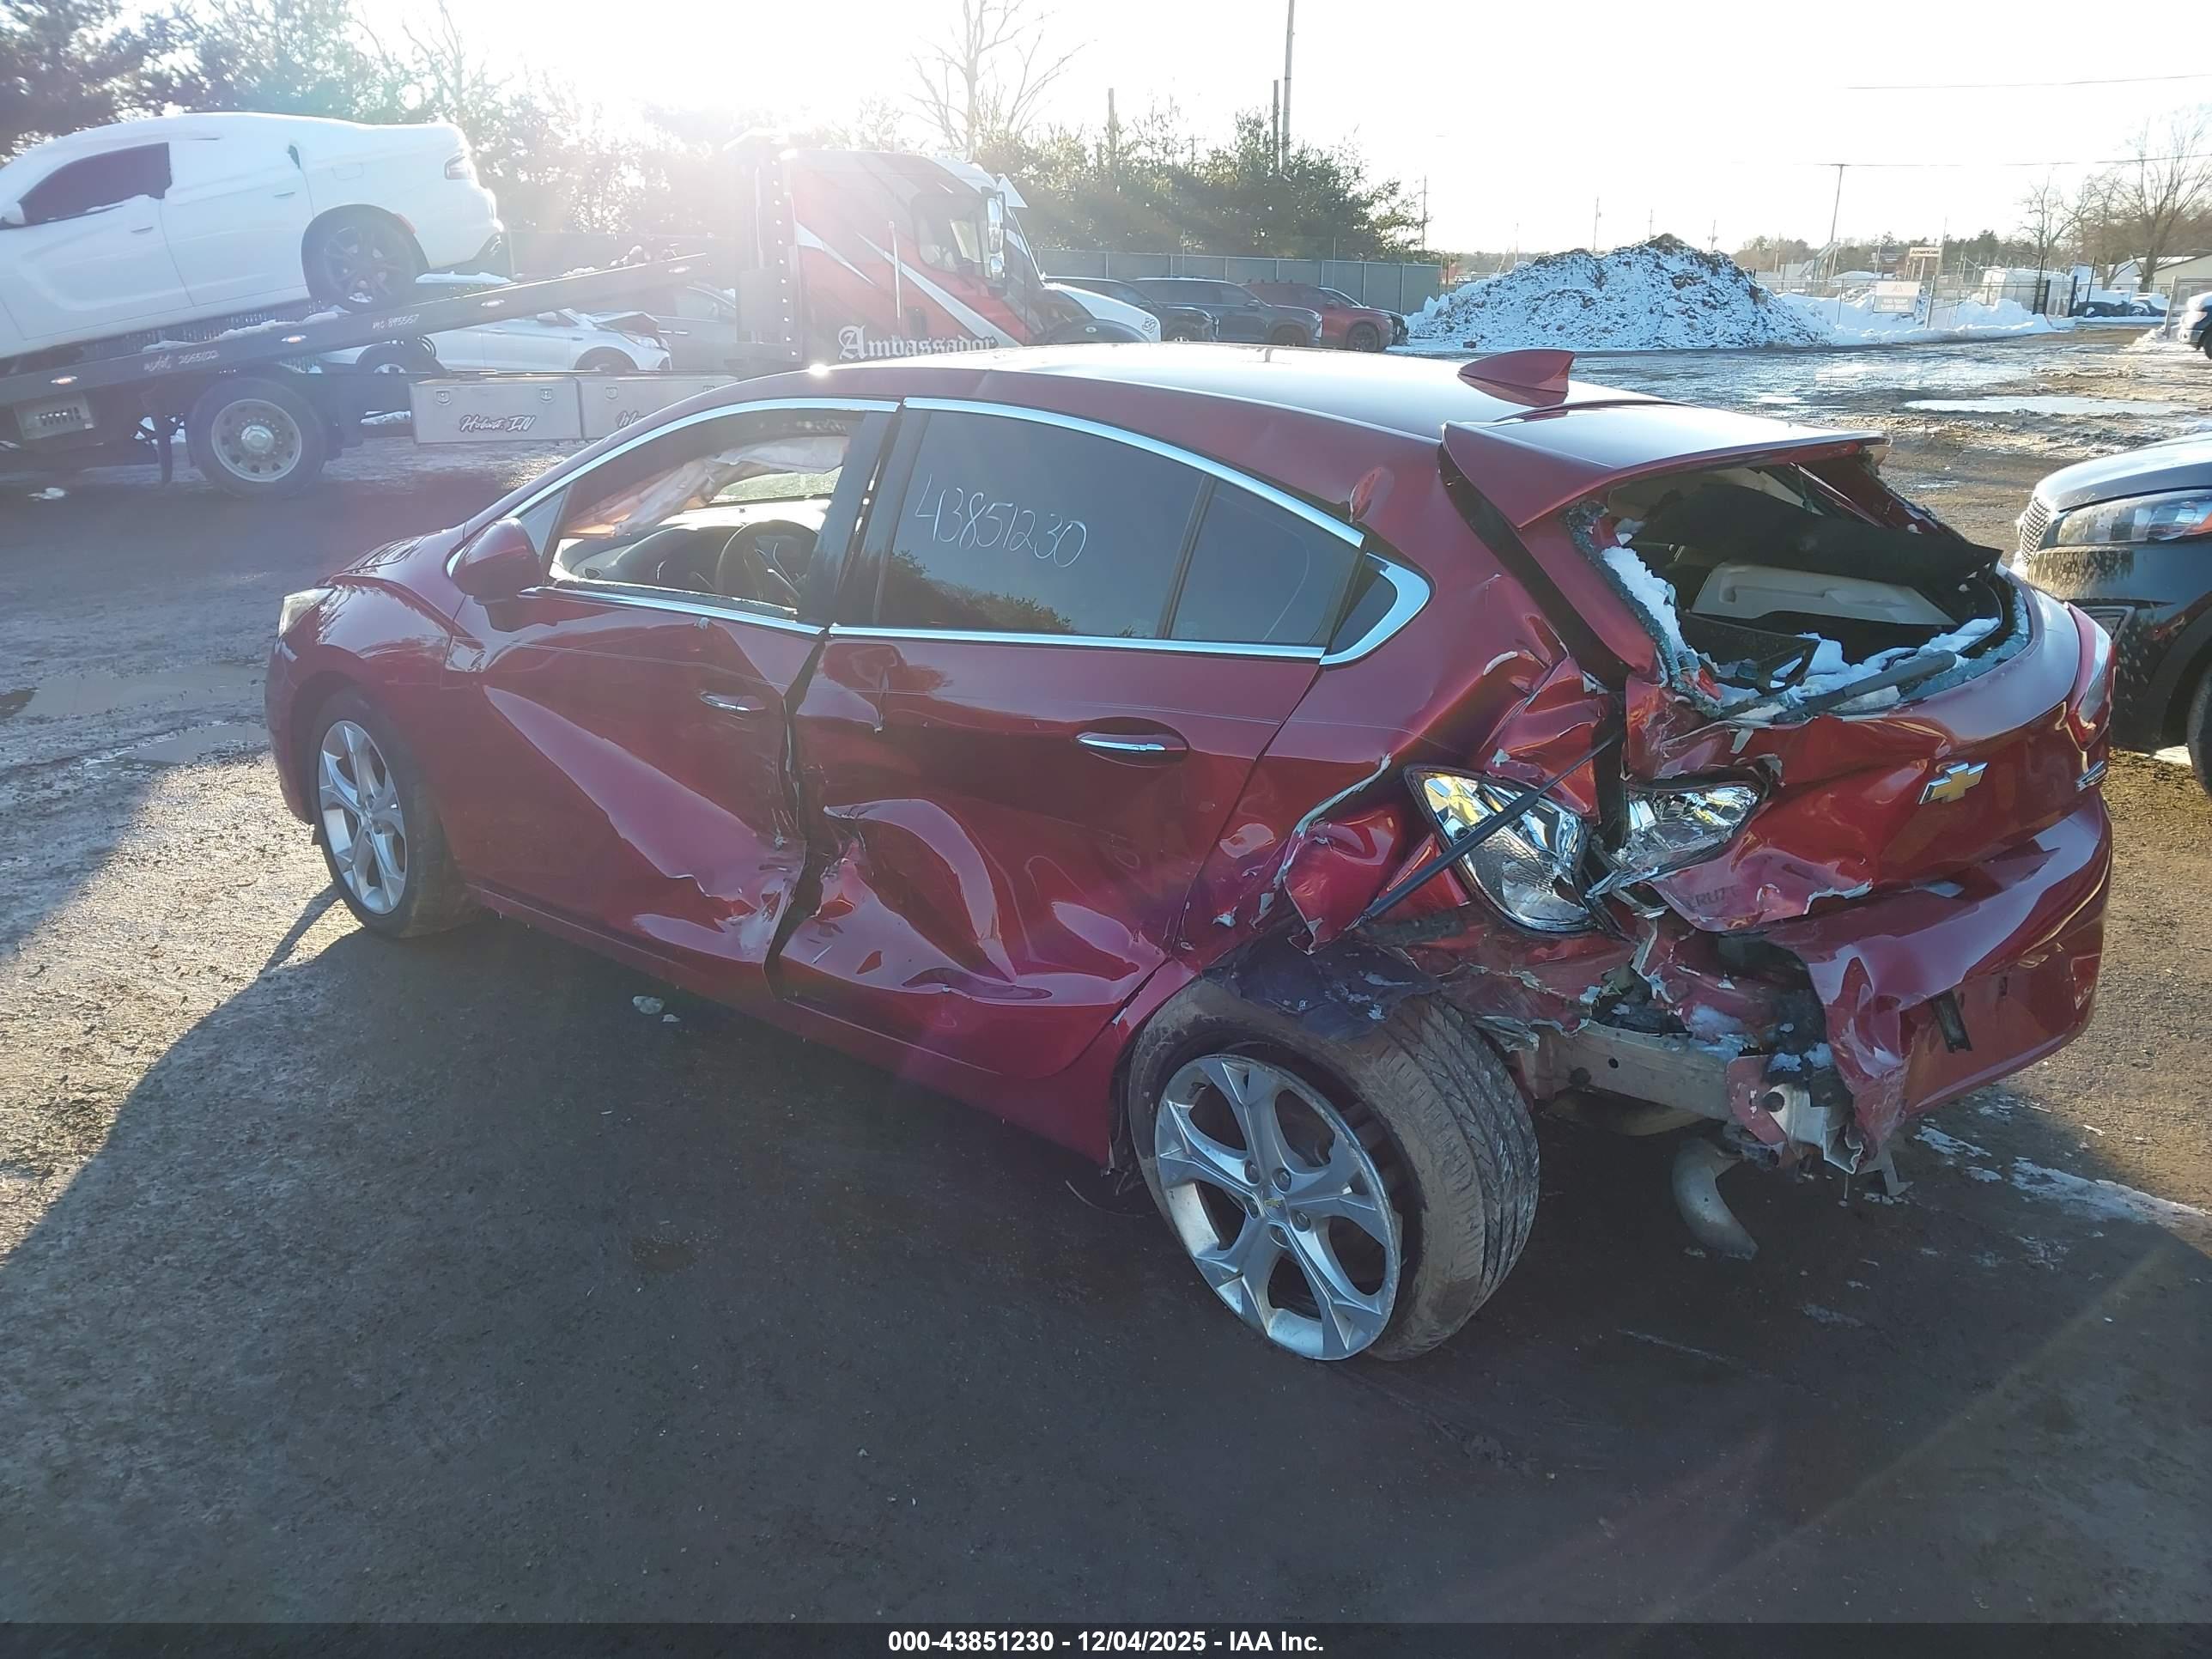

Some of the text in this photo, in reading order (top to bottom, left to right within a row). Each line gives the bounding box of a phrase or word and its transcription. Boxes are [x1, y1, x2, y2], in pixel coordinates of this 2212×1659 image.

[837, 324, 1000, 361] Ambassador
[506, 414, 537, 433] IN
[915, 473, 1088, 568] 43851230
